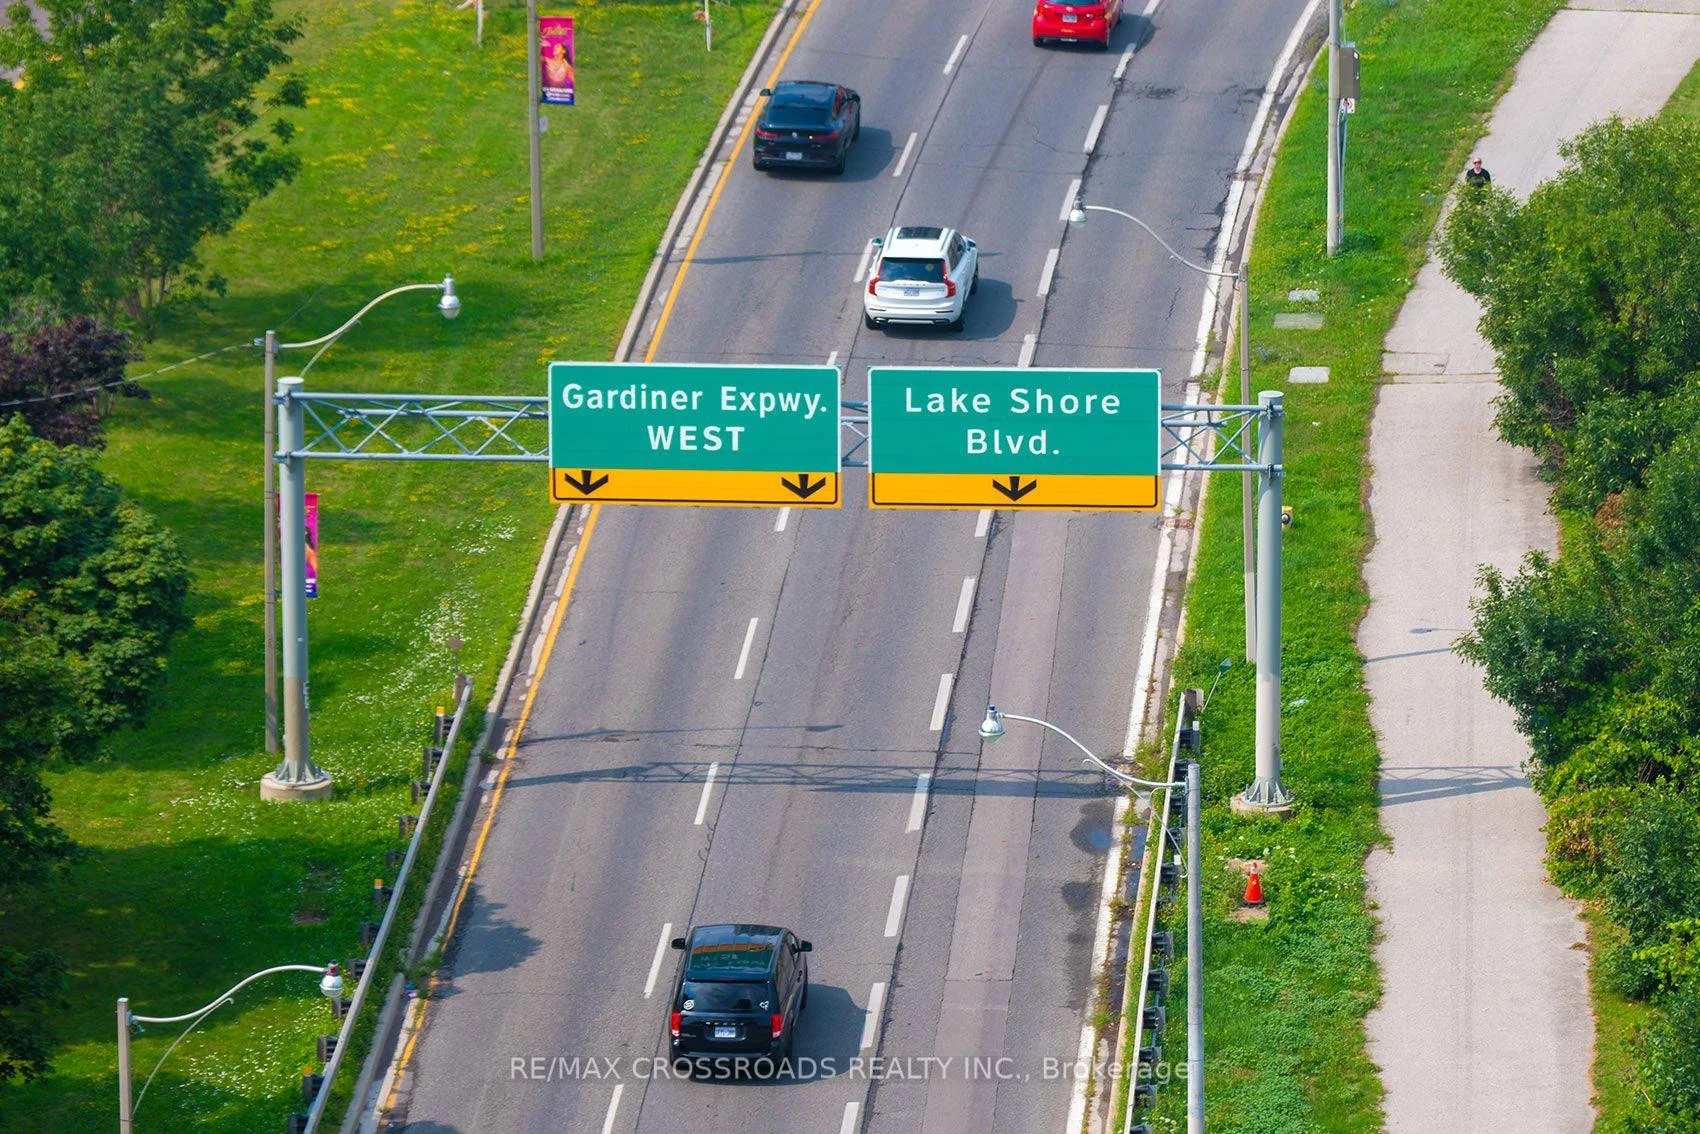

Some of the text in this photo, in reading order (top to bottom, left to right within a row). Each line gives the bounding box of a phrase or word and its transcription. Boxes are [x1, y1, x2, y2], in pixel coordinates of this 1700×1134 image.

[562, 383, 827, 420] Gardiner Expwy.
[905, 387, 1120, 415] Lake Shore
[647, 425, 745, 451] WEST
[967, 428, 1060, 455] Blvd.
